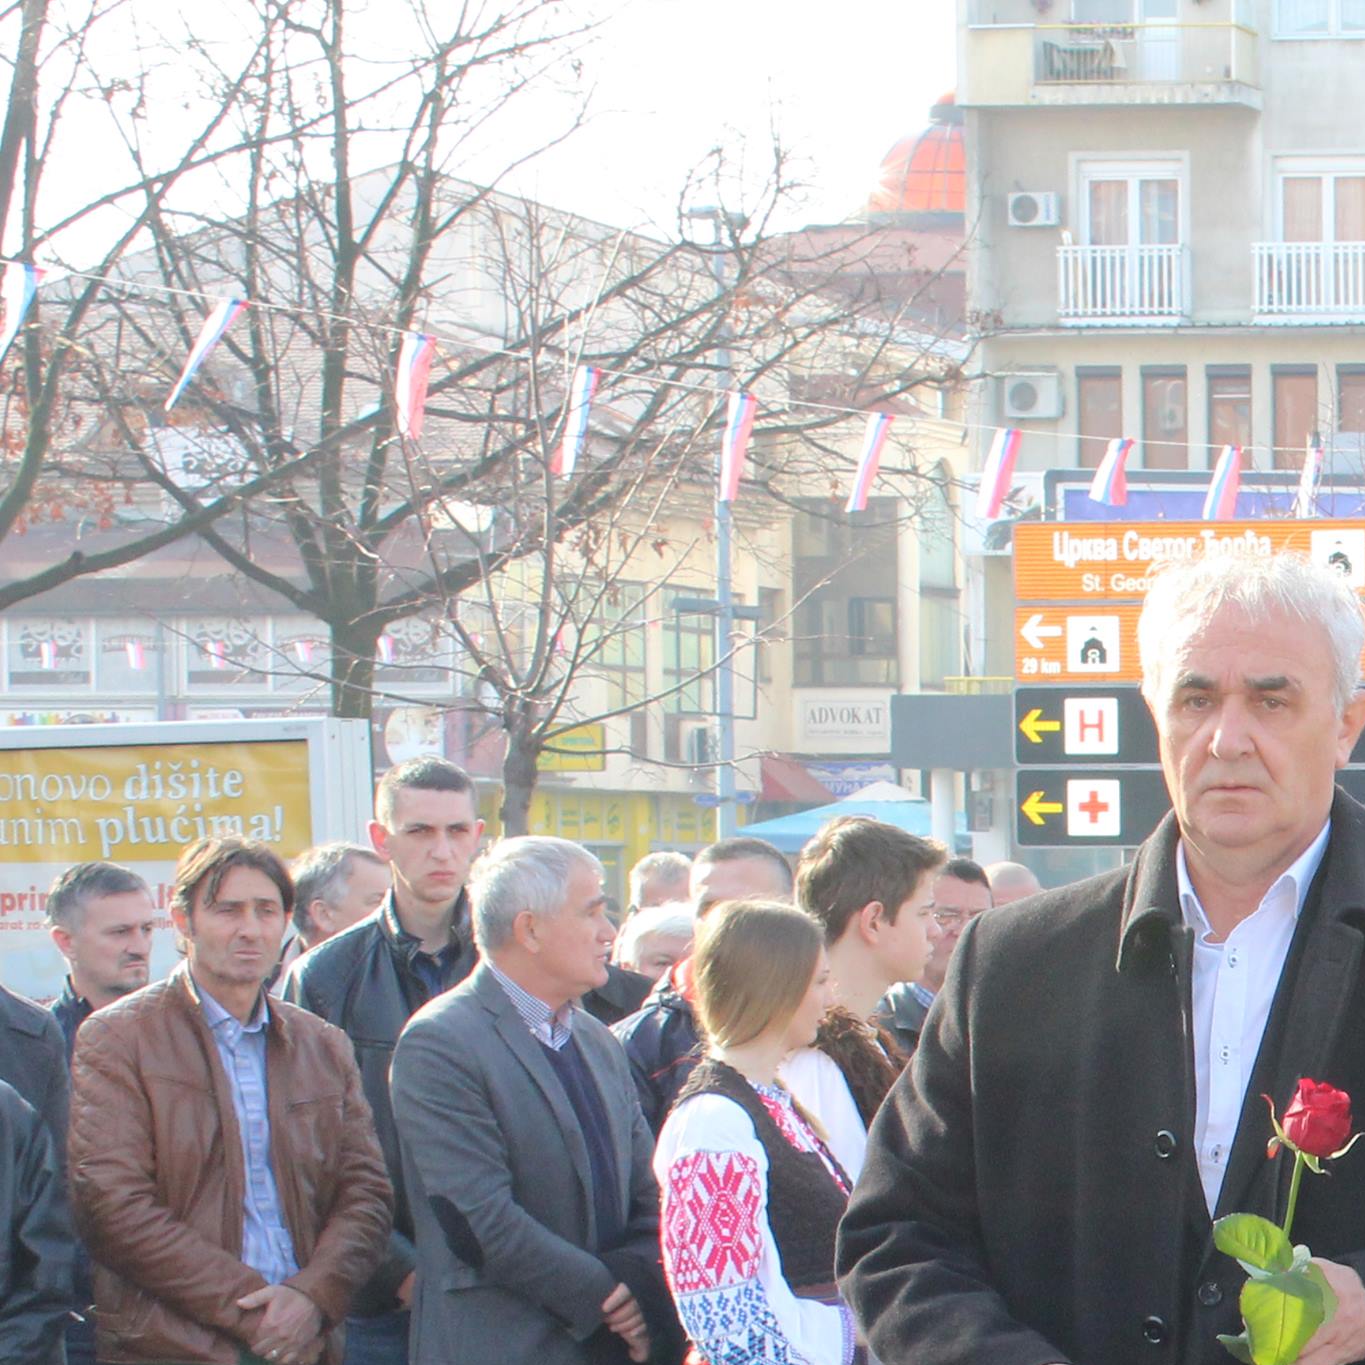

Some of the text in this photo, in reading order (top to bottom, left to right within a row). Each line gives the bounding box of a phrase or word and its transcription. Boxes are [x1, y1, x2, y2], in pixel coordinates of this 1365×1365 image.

[1053, 531, 1118, 568] Црква
[1082, 573, 1105, 592] St.
[1021, 657, 1061, 674] 29 km
[808, 706, 883, 725] ADVOKAT
[1079, 709, 1104, 742] H
[0, 759, 244, 801] onovo dišite
[96, 803, 284, 859] plućima!
